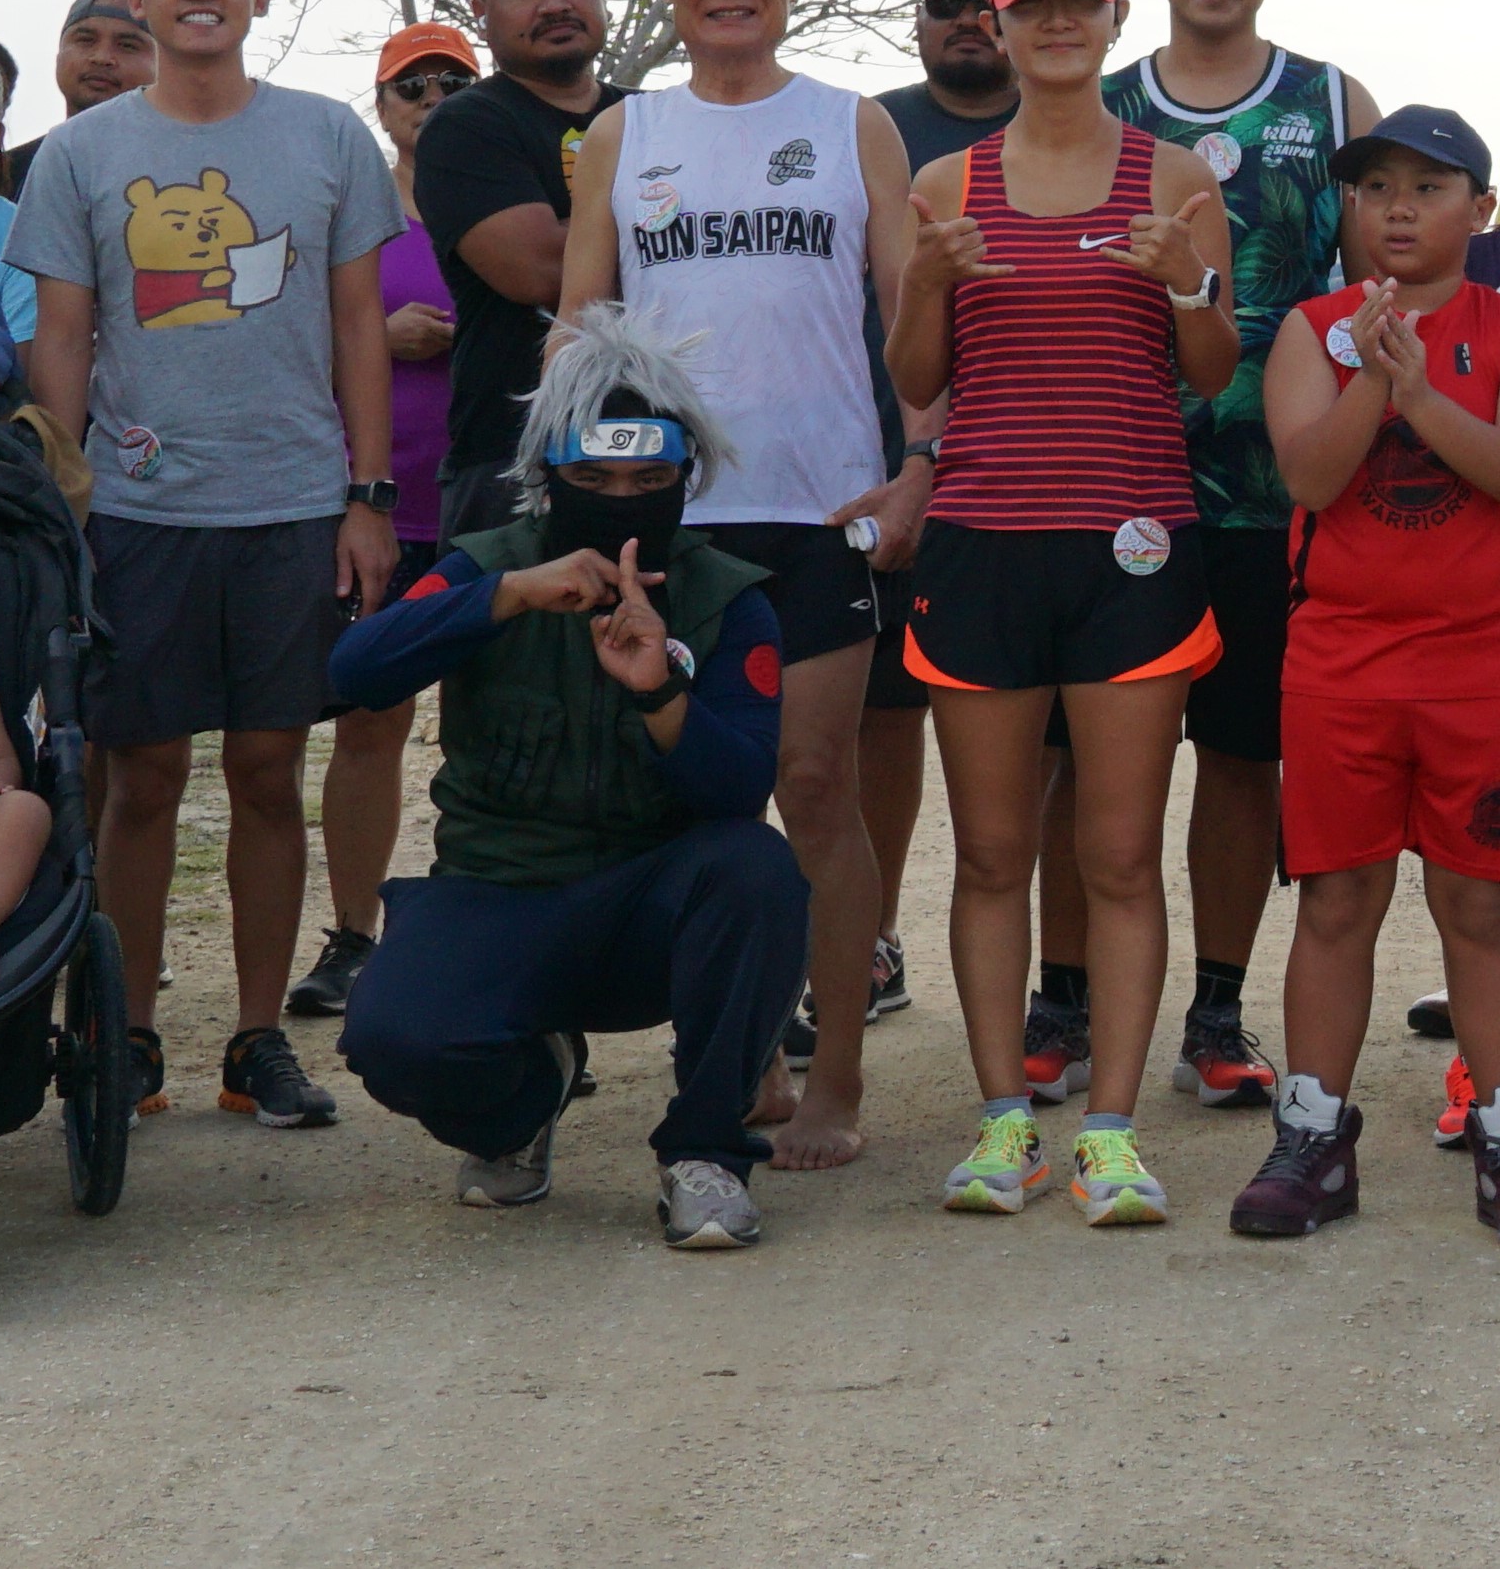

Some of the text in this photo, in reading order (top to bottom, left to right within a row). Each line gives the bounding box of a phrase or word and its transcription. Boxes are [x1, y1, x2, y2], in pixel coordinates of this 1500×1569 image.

[1262, 124, 1316, 144] RUN
[701, 206, 837, 260] SAIPAN
[1357, 481, 1472, 531] WARRIORS
